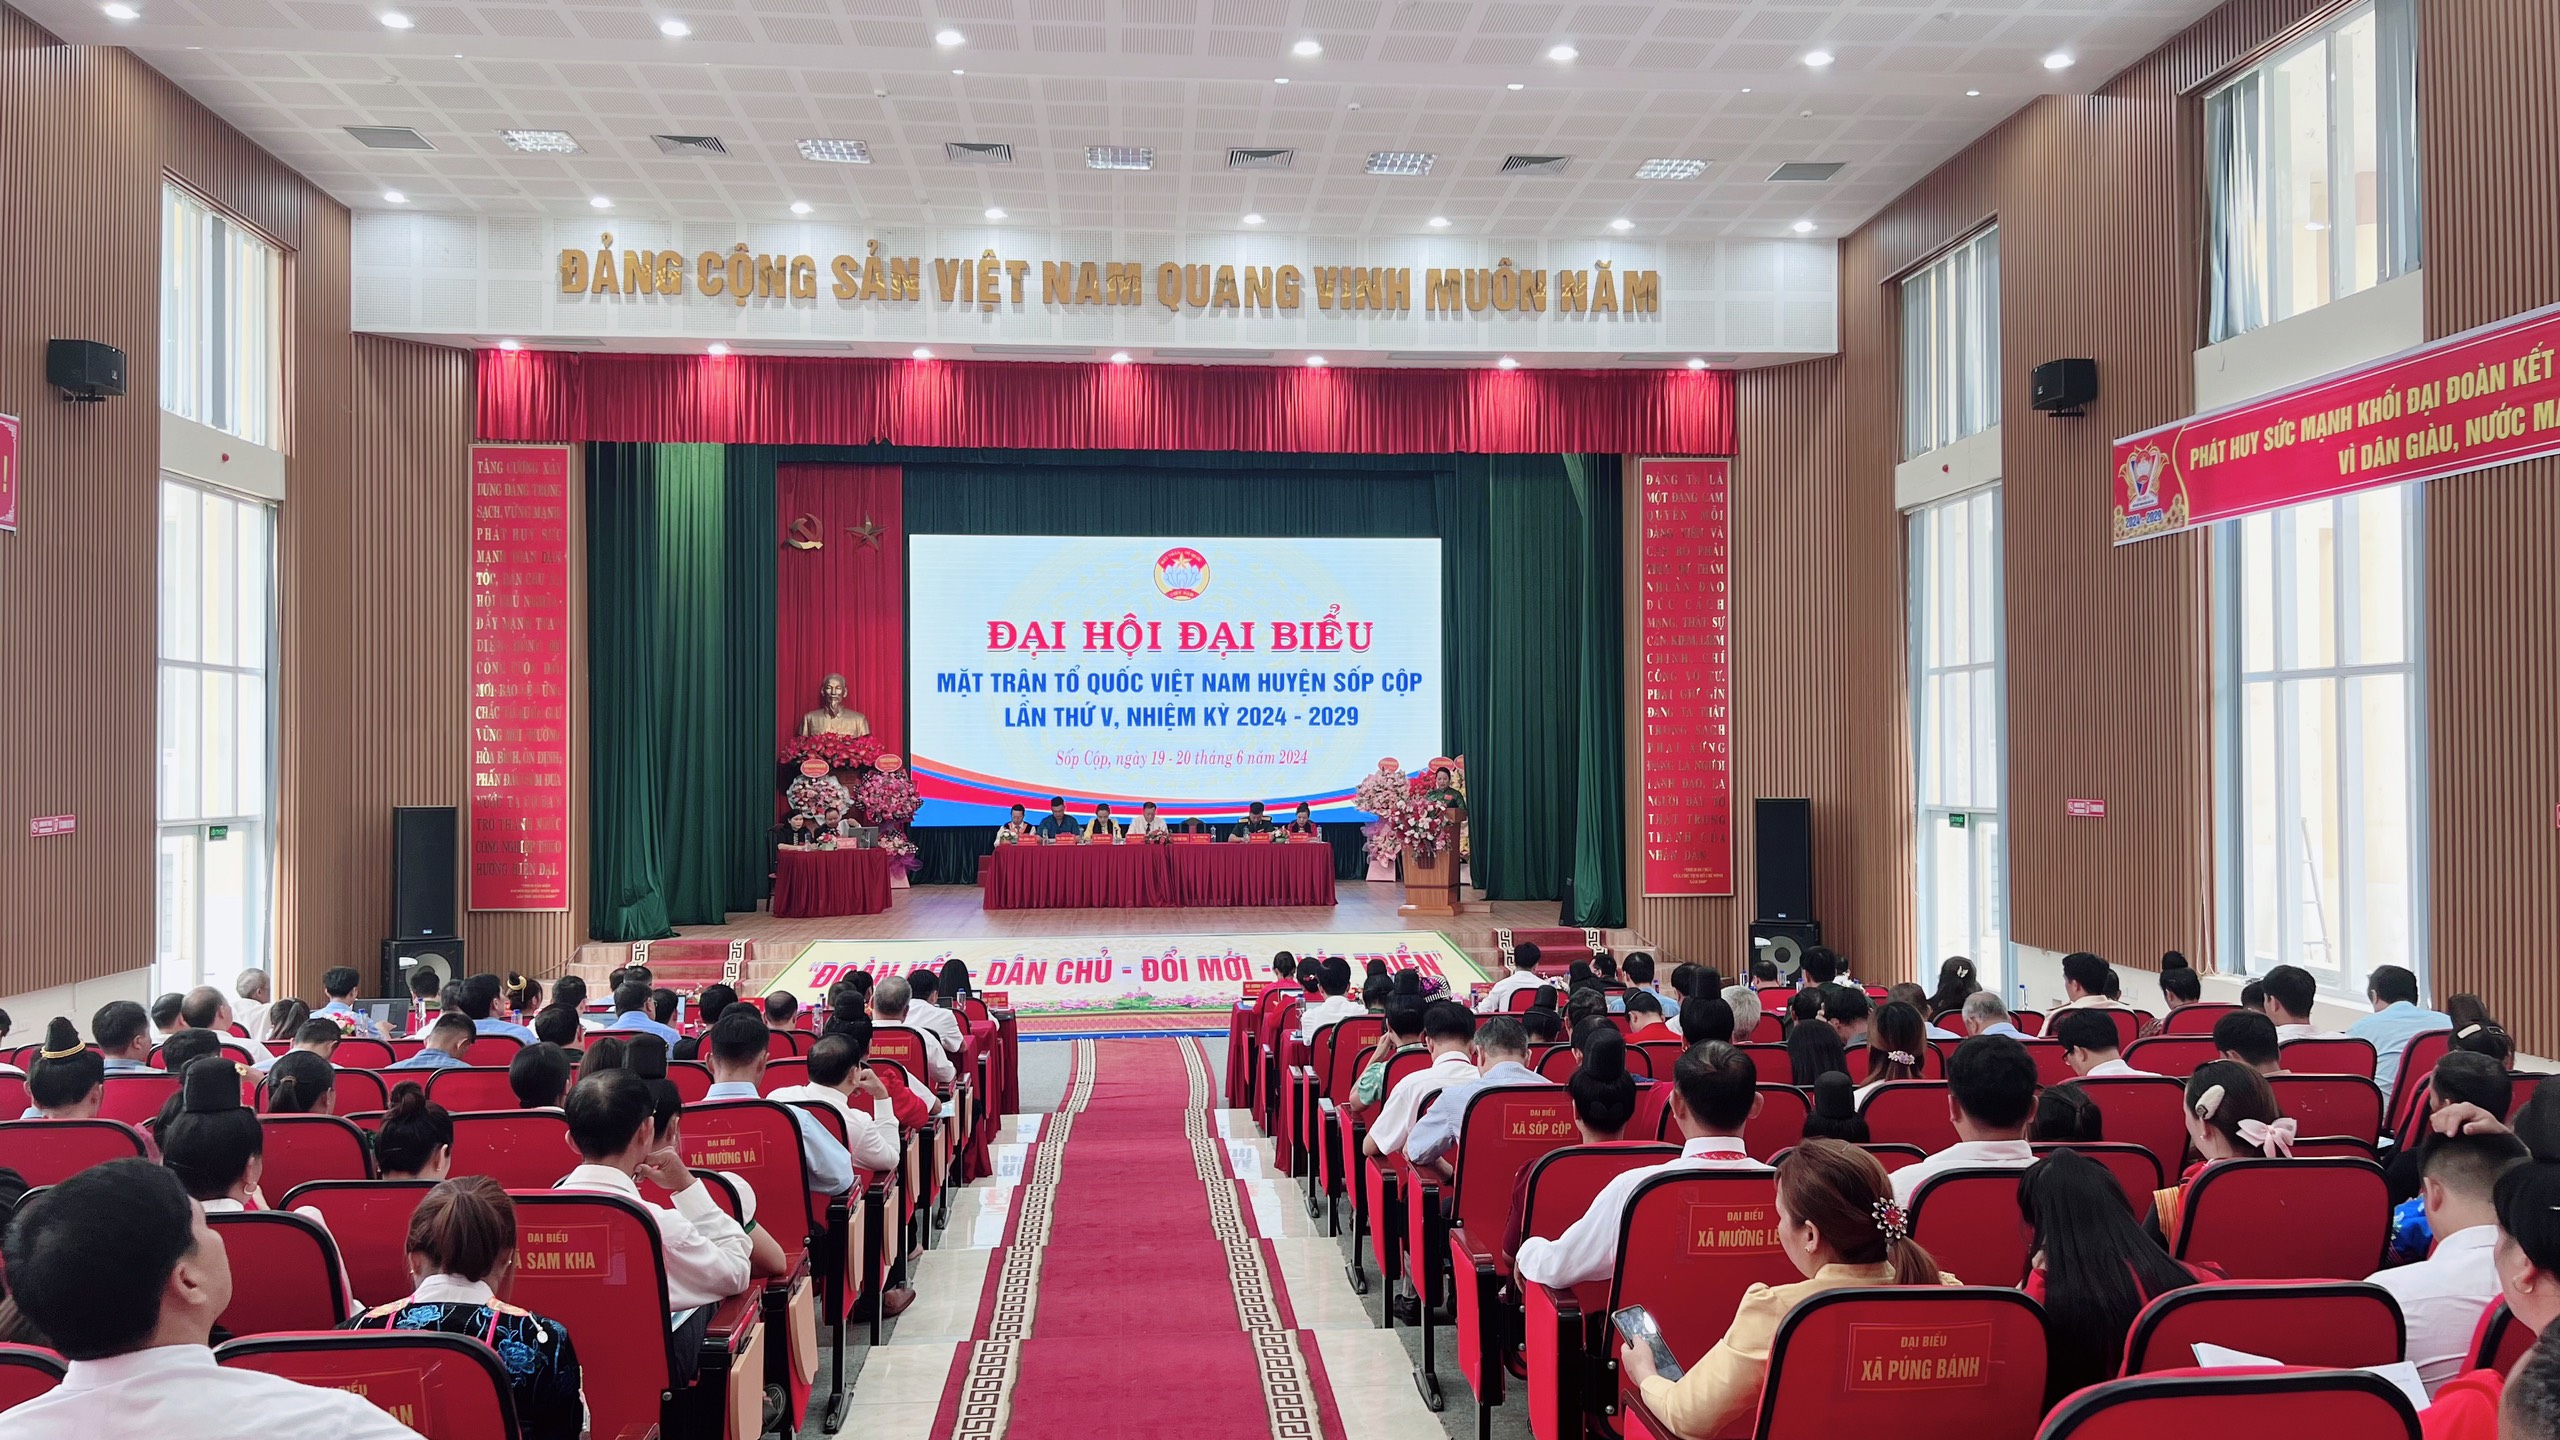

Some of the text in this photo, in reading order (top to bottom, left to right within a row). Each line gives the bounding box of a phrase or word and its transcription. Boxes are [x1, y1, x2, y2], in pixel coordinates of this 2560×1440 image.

[562, 231, 1659, 312] ĐẢNG CỘNG SẢN VIỆT NAM QUANG VINH MUÔN NĂM
[2190, 341, 2555, 471] PHÁT HUY SỨC MẠNH KHỐI ĐẠI ĐOÀN KẾT
[2338, 442, 2356, 475] VÌ
[2361, 435, 2400, 471] DÂN
[2405, 423, 2459, 461] GIÀU,
[2465, 402, 2526, 448] NƯỚC
[477, 458, 503, 474] TĂNG
[1646, 490, 1669, 505] MỘT
[2126, 514, 2140, 529] 2024
[2147, 509, 2162, 523] 2029
[986, 603, 1373, 660] ĐẠI HỘI ĐẠI BIỂU
[1711, 615, 1726, 631] SỰ
[937, 664, 1422, 697] MẶT TRẬN TỔ QUỐC VIỆT NAM HUYỆN SỐP CỘP
[1005, 700, 1046, 727] LẦN
[1054, 701, 1096, 727] THỨ
[1101, 706, 1119, 729] V,
[1127, 703, 1196, 731] NHIỆM
[1204, 702, 1230, 726] KỲ
[1237, 706, 1287, 726] 2024
[1308, 706, 1359, 727] 2029
[475, 746, 495, 764] HÒA
[1055, 748, 1079, 768] Sốp
[1084, 750, 1112, 770] Cộp,
[1116, 751, 1147, 768] ngày
[1151, 750, 1165, 765] 19
[1176, 750, 1191, 765] 20
[1195, 750, 1233, 769] tháng
[1236, 750, 1244, 765] 6
[1247, 750, 1275, 766] năm
[1279, 749, 1308, 765] 2024
[475, 767, 501, 786] PHẤN
[985, 953, 1048, 986] DÂN
[1055, 945, 1112, 985] CHỦ
[1141, 945, 1187, 983] ĐỔI
[1196, 947, 1253, 982] MỚI
[1512, 1119, 1572, 1137] XÃ SỐP CỘP
[691, 1147, 756, 1166] XÃ MƯỜNG VÀ
[1727, 1207, 1764, 1223] ĐẠI BIỂU
[527, 1229, 569, 1245] ĐẠI BIỂU
[1697, 1227, 1715, 1247] XÃ
[1718, 1225, 1764, 1247] MƯỜNG
[527, 1252, 560, 1270] SAM
[565, 1251, 596, 1270] KHA
[1901, 1330, 1947, 1351] ĐẠI BIỂU
[1861, 1353, 1980, 1381] XÃ PÚNG BÁNH
